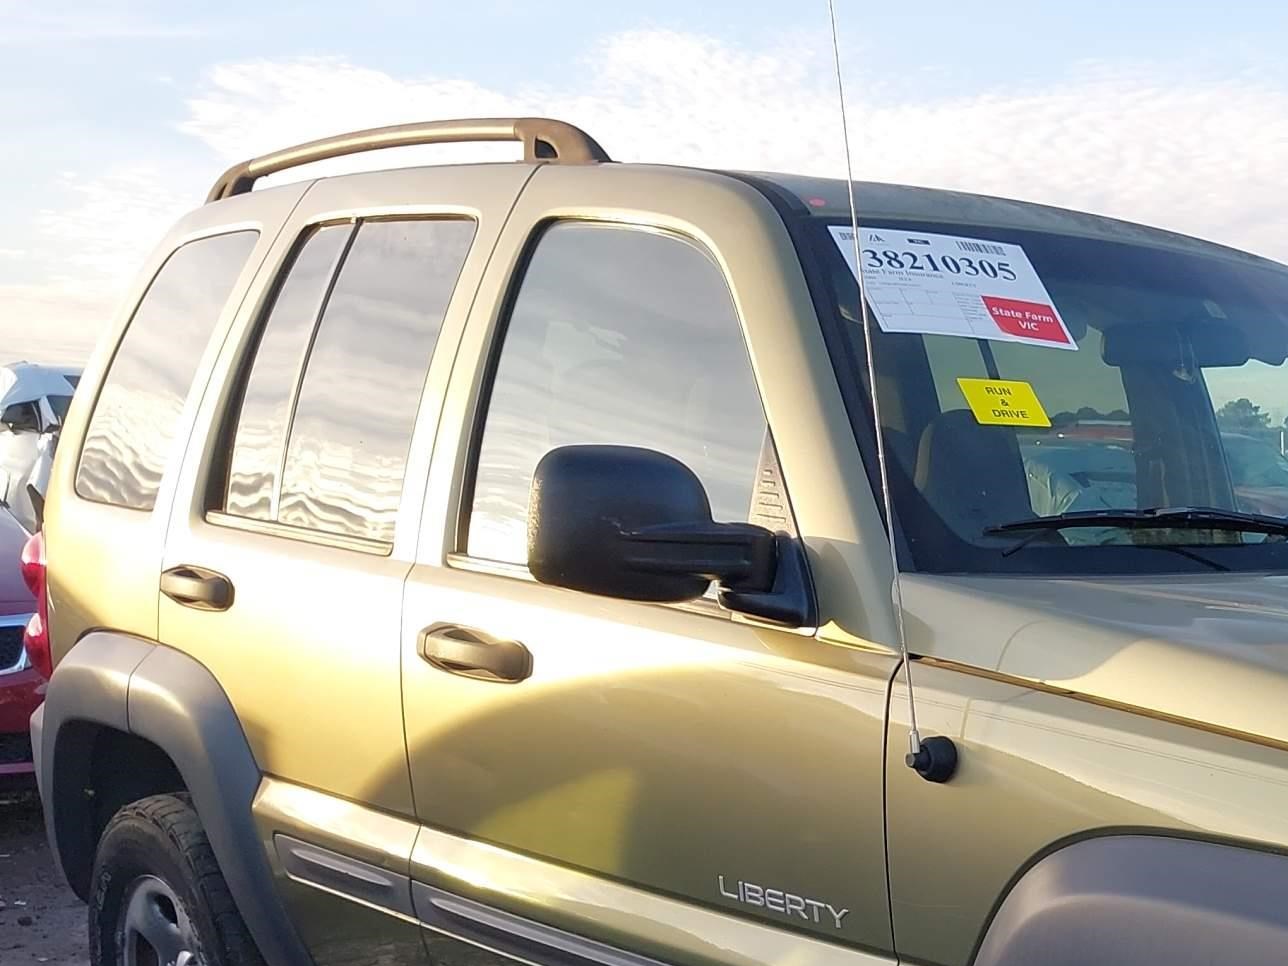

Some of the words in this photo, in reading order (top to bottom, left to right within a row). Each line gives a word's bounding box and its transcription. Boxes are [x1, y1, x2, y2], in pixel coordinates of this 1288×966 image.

[861, 248, 1017, 281] 38210305
[991, 306, 1022, 319] State
[1025, 311, 1054, 323] Farm
[1018, 320, 1039, 331] VIC
[985, 386, 1012, 396] RUN
[1000, 398, 1009, 407] &
[992, 409, 1029, 419] DRIVE
[718, 874, 849, 929] LIBERTY
